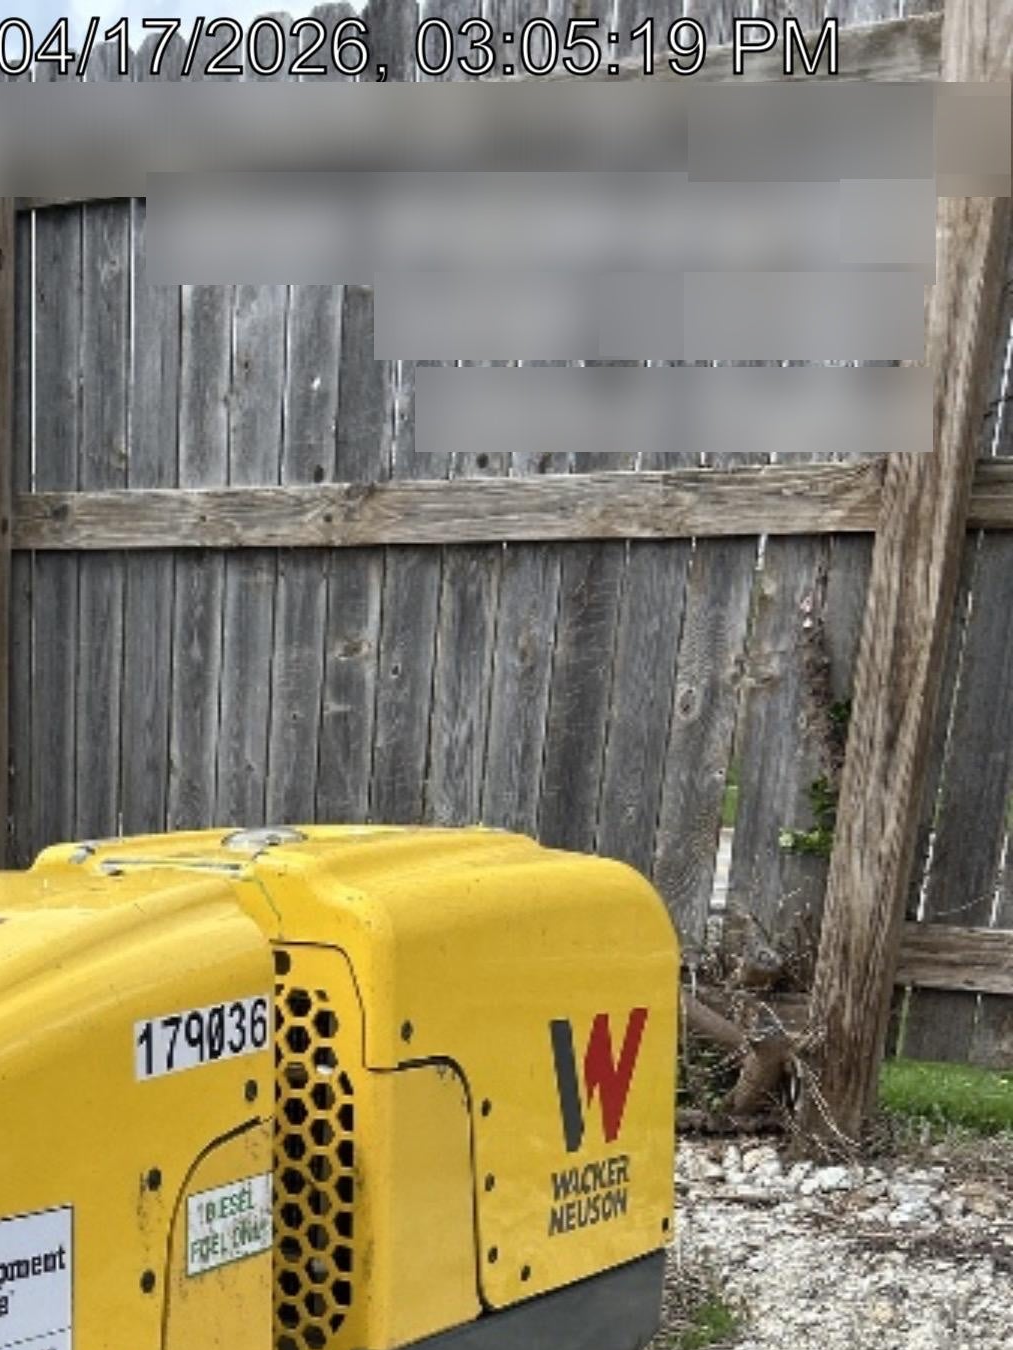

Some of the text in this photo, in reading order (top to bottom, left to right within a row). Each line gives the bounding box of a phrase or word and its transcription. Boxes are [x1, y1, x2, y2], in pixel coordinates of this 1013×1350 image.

[137, 998, 267, 1075] 179036
[550, 1154, 631, 1201] WACKER
[548, 1188, 628, 1237] NEUSON
